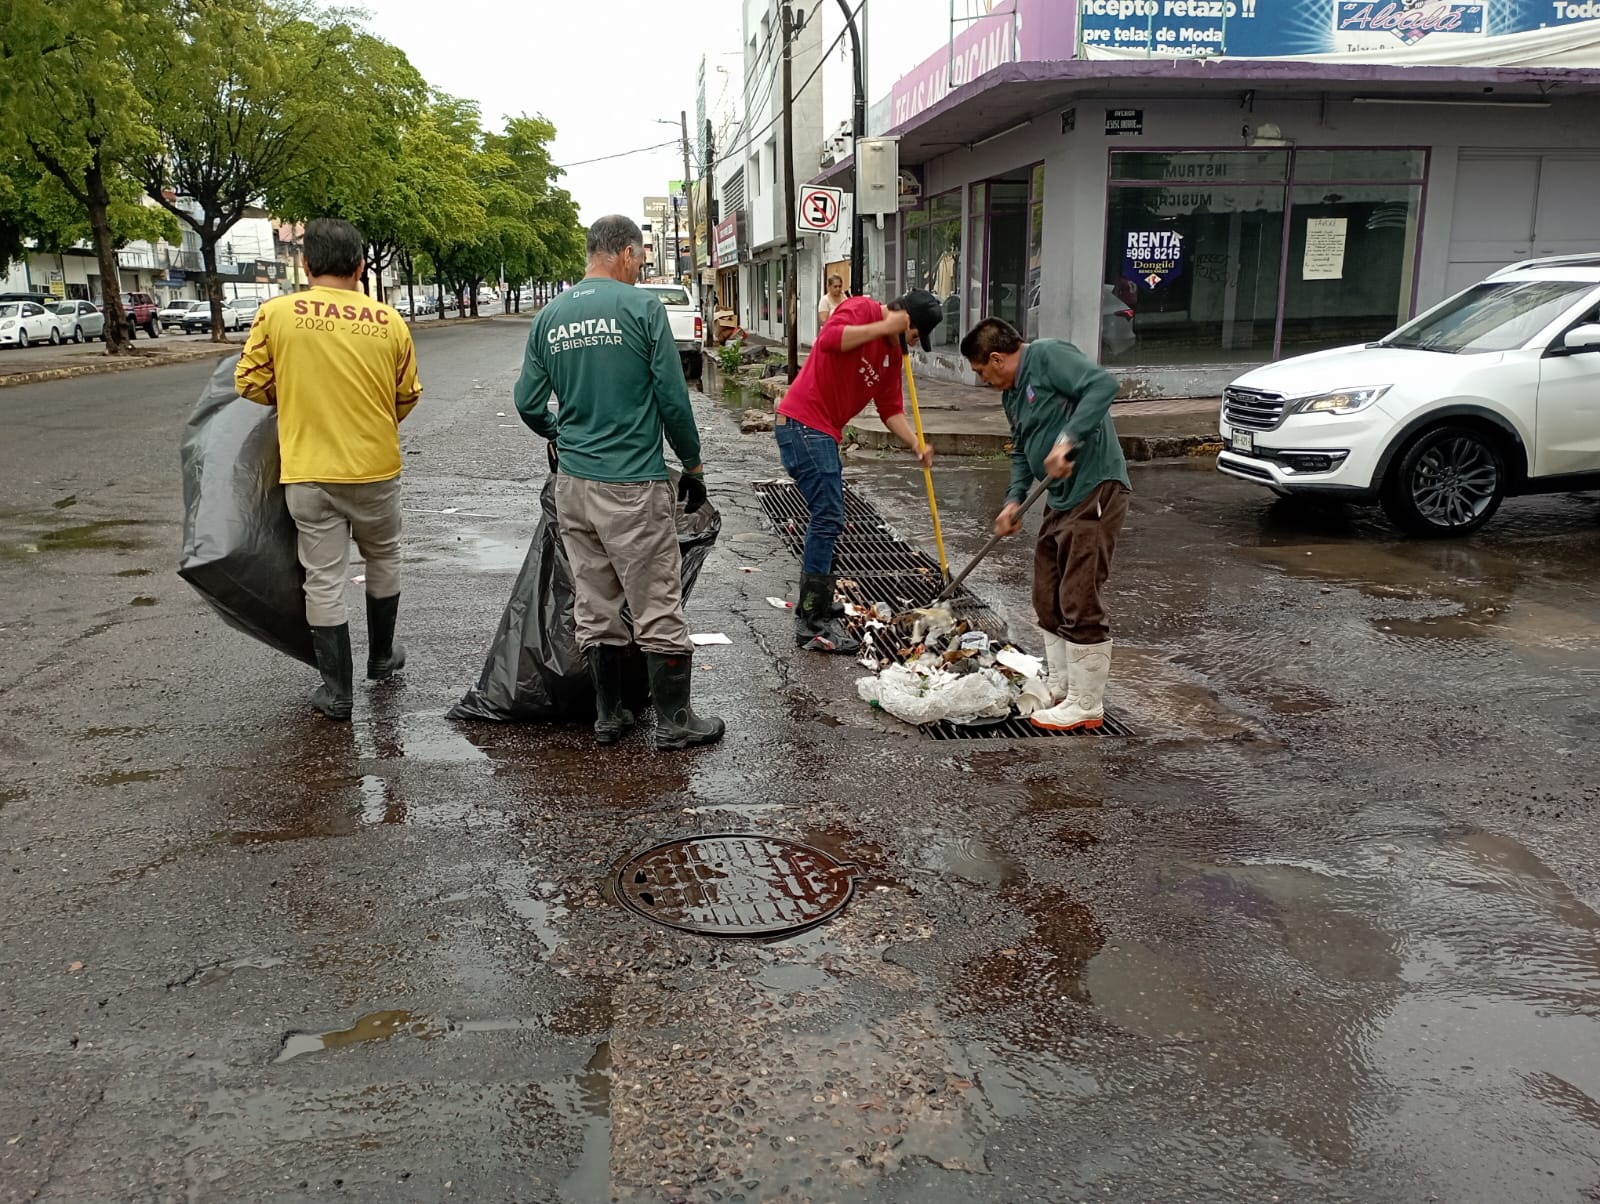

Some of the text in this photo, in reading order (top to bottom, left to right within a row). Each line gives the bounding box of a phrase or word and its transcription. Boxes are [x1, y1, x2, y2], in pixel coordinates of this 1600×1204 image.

[1164, 0, 1236, 18] retazo
[1083, 26, 1223, 42] pre telas de Moda
[1127, 231, 1181, 248] RENTA
[1131, 247, 1180, 260] 996 8215
[1133, 260, 1175, 271] Dongild
[294, 299, 390, 326] STASAC
[295, 317, 335, 332] 2020
[351, 322, 388, 340] 2023
[547, 318, 623, 344] CAPITAL
[550, 335, 623, 355] DE BIENESTAR
